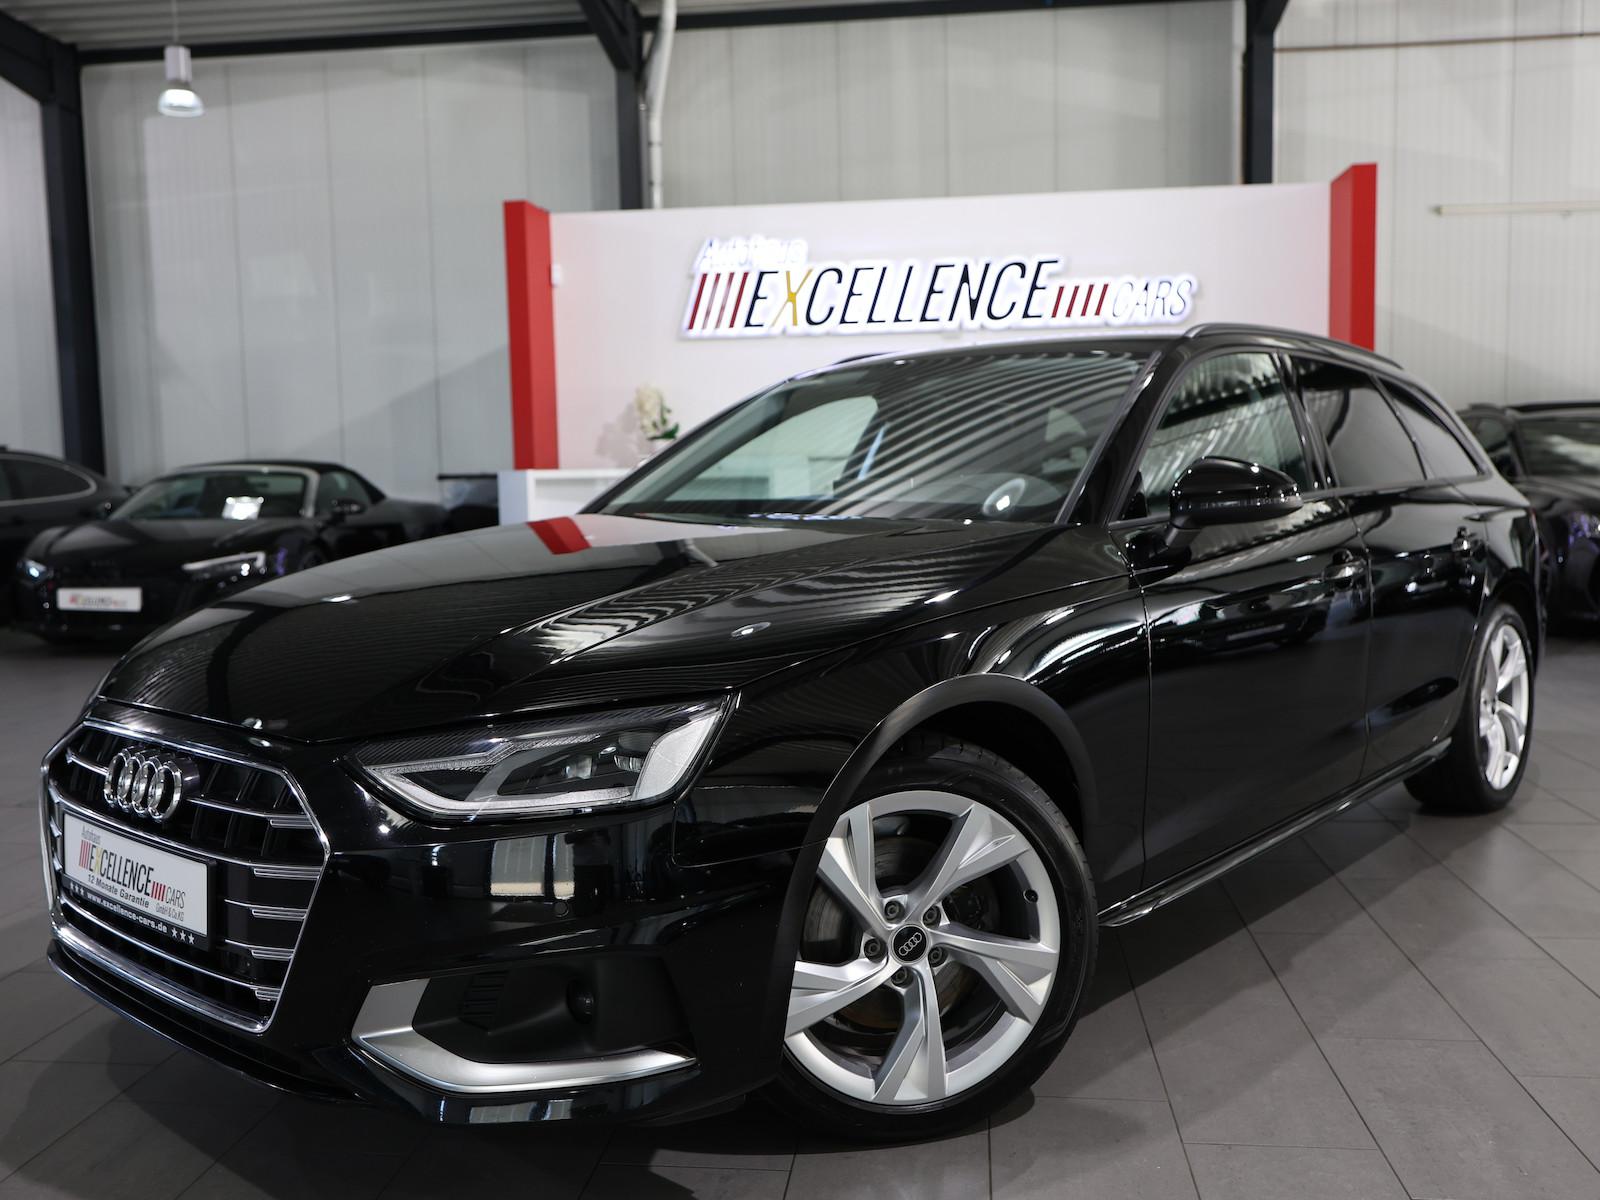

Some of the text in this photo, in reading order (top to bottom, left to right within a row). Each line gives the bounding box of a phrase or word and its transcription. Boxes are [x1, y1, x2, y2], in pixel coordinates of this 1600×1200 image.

[743, 259, 1193, 328] EXCELLENCE CARS
[88, 843, 186, 909] EXCELLENCE CARS
[88, 873, 150, 909] 12 Monate Garantie
[86, 891, 168, 934] www.excellence-cars.de
